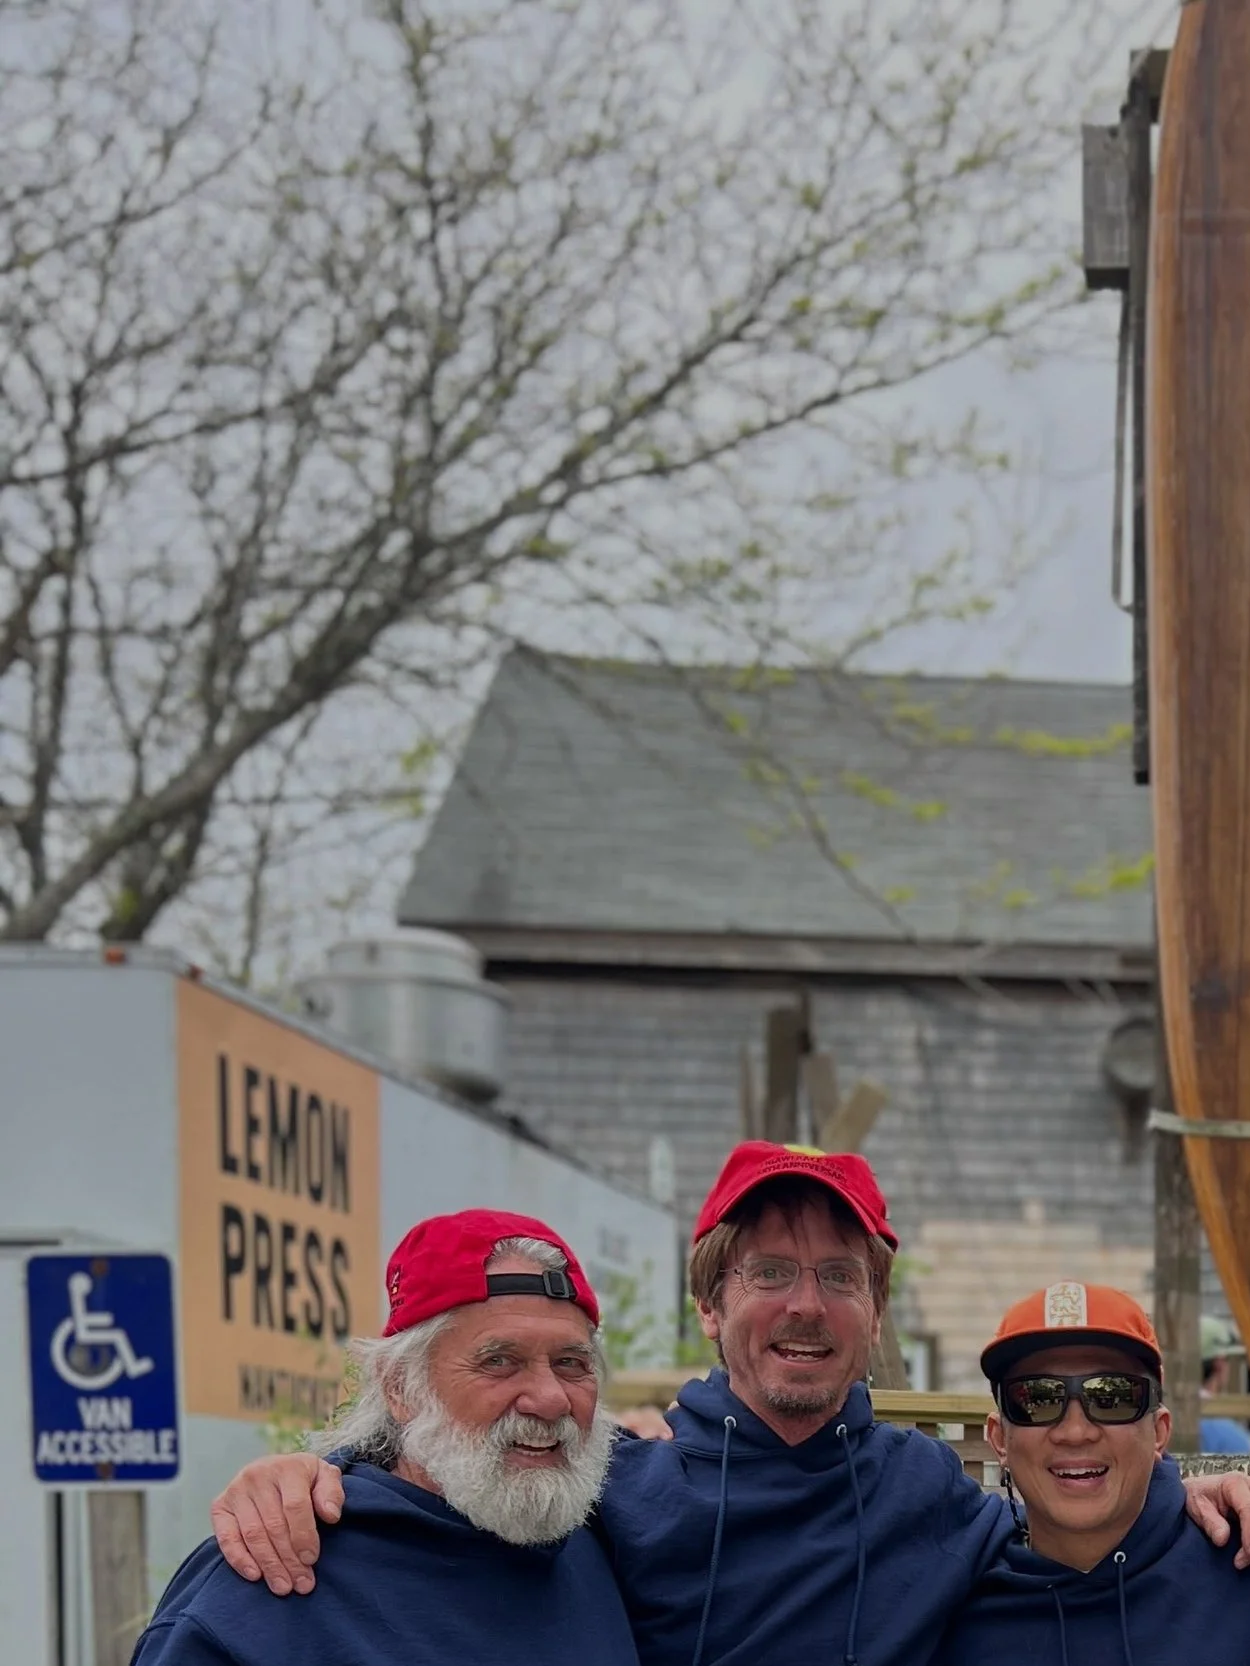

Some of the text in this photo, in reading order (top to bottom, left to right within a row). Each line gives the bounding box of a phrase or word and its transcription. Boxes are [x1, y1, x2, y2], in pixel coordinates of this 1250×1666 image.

[218, 1052, 350, 1215] LEMON
[221, 1202, 350, 1343] PRESS
[36, 1429, 177, 1465] ACCESSIBLE
[76, 1397, 133, 1431] VAN
